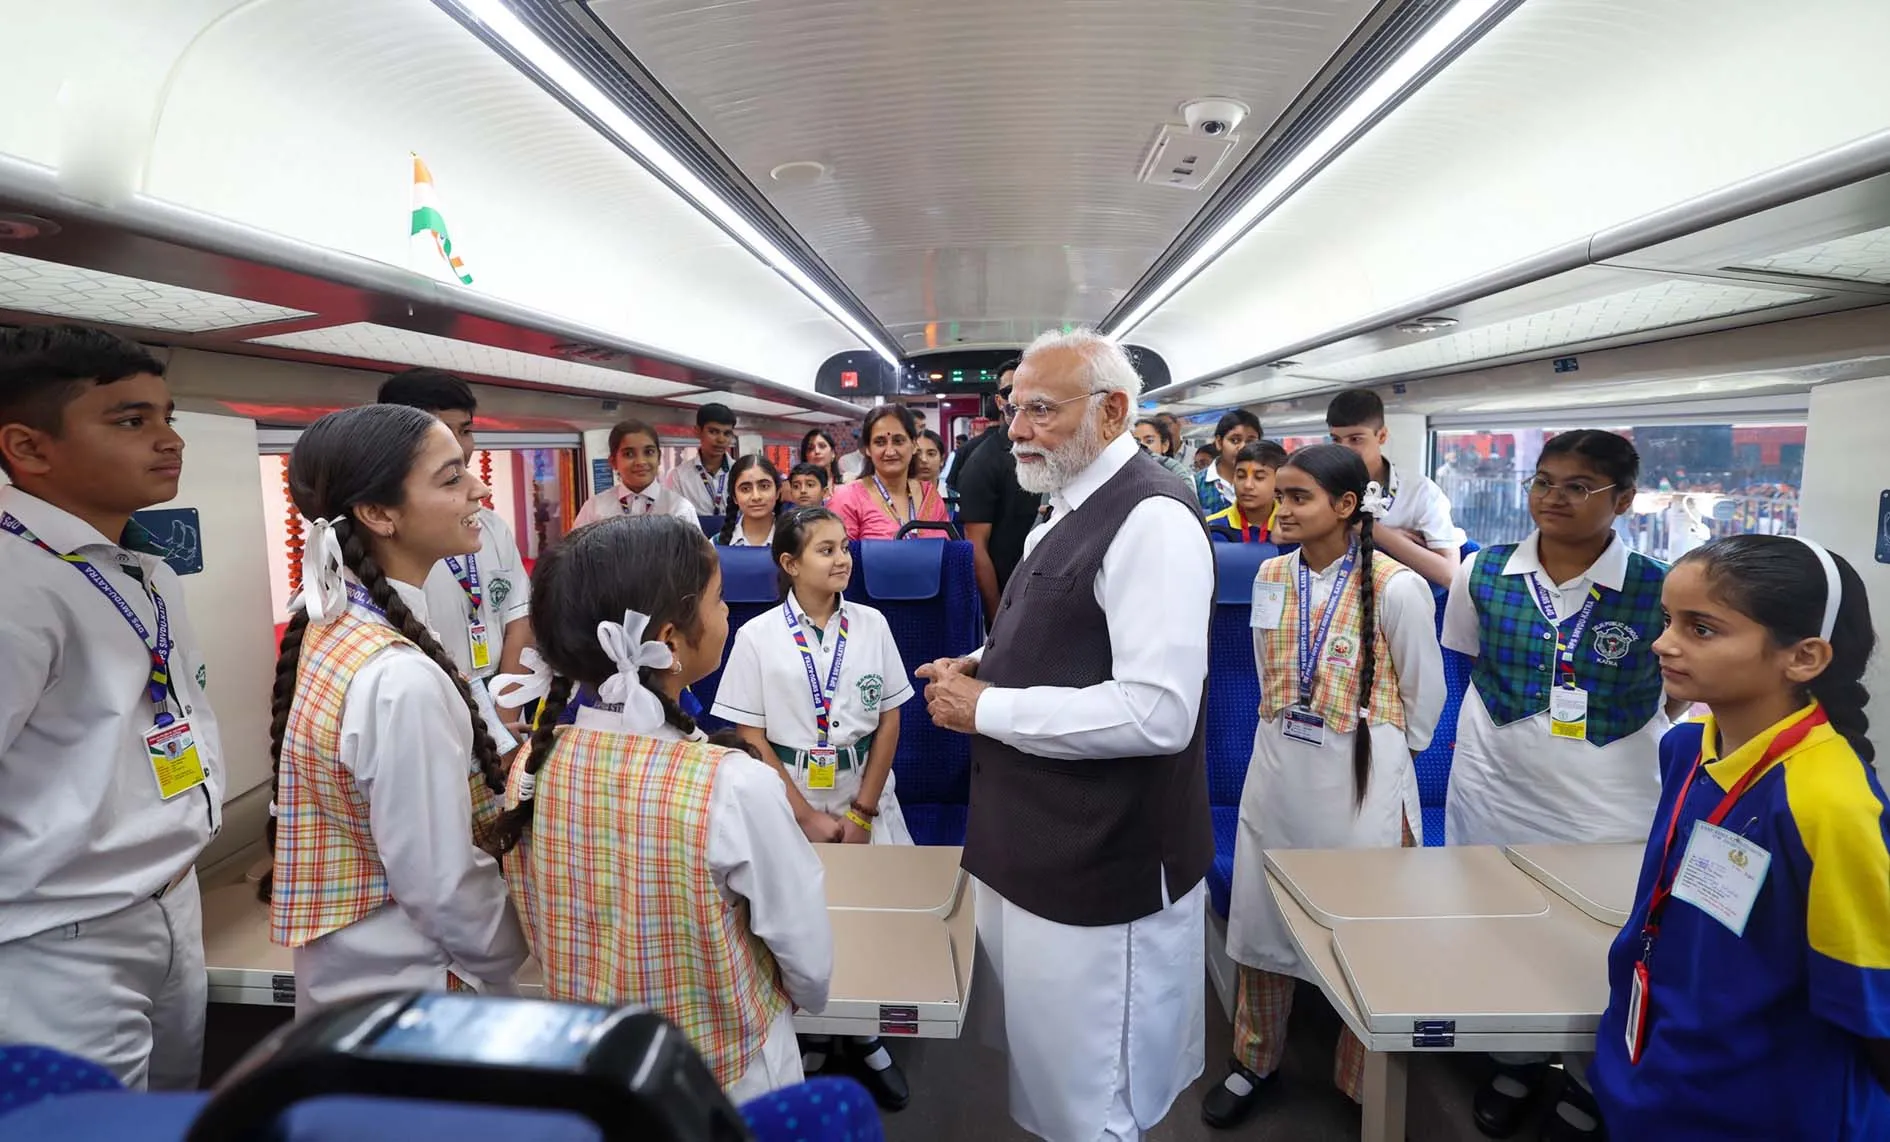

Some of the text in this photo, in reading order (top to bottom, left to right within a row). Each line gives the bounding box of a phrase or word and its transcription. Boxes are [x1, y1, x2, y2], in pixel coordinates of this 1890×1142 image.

[3, 516, 20, 529] DPS
[1333, 577, 1344, 594] KATRA
[85, 566, 144, 633] DPS SMVDU-KATRA
[1544, 604, 1555, 616] DPS
[1567, 639, 1578, 649] DPS
